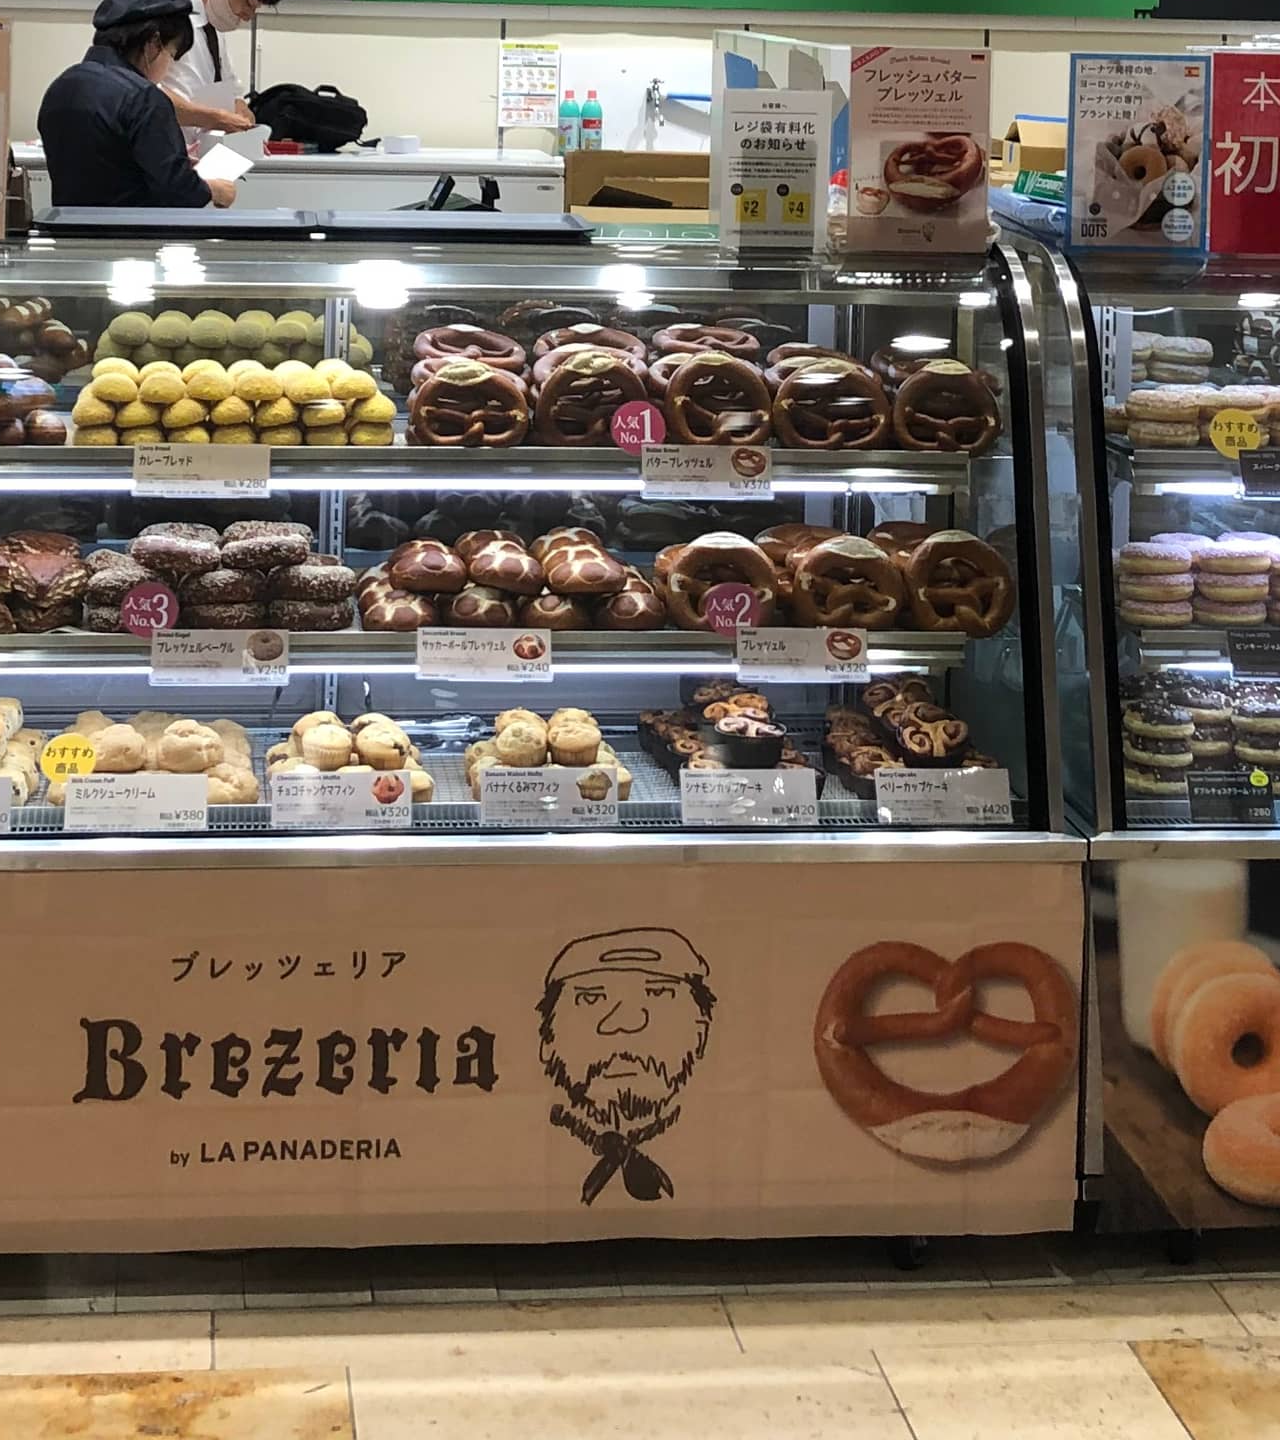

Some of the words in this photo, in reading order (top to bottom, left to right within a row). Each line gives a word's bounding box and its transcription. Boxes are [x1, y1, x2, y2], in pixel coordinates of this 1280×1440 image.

[863, 69, 977, 85] フレッシュバター
[877, 86, 963, 103] ブレッツェル
[734, 120, 816, 135] レジ袋有料化
[740, 138, 807, 152] のお知らせ
[1081, 223, 1108, 238] DOTS
[614, 415, 640, 429] 人気
[620, 433, 640, 443] No.
[639, 408, 655, 443] 1
[139, 456, 193, 467] カレーブレッド
[124, 598, 152, 612] 人気
[129, 614, 150, 627] No.
[151, 594, 169, 629] 3
[710, 598, 735, 612] 人気
[715, 615, 735, 627] No.
[735, 593, 752, 627] 2
[45, 747, 94, 759] おすすめ
[55, 763, 79, 774] 商品
[75, 787, 156, 800] ミルクシュークリーム
[174, 809, 204, 821] ¥380
[380, 807, 410, 817] ¥320
[586, 804, 616, 816] ¥320
[171, 950, 406, 982] ブレッツェリア
[72, 1017, 500, 1104] Brezeria
[170, 1149, 191, 1167] by
[200, 1142, 236, 1163] LA
[243, 1138, 402, 1161] PANADERIA
